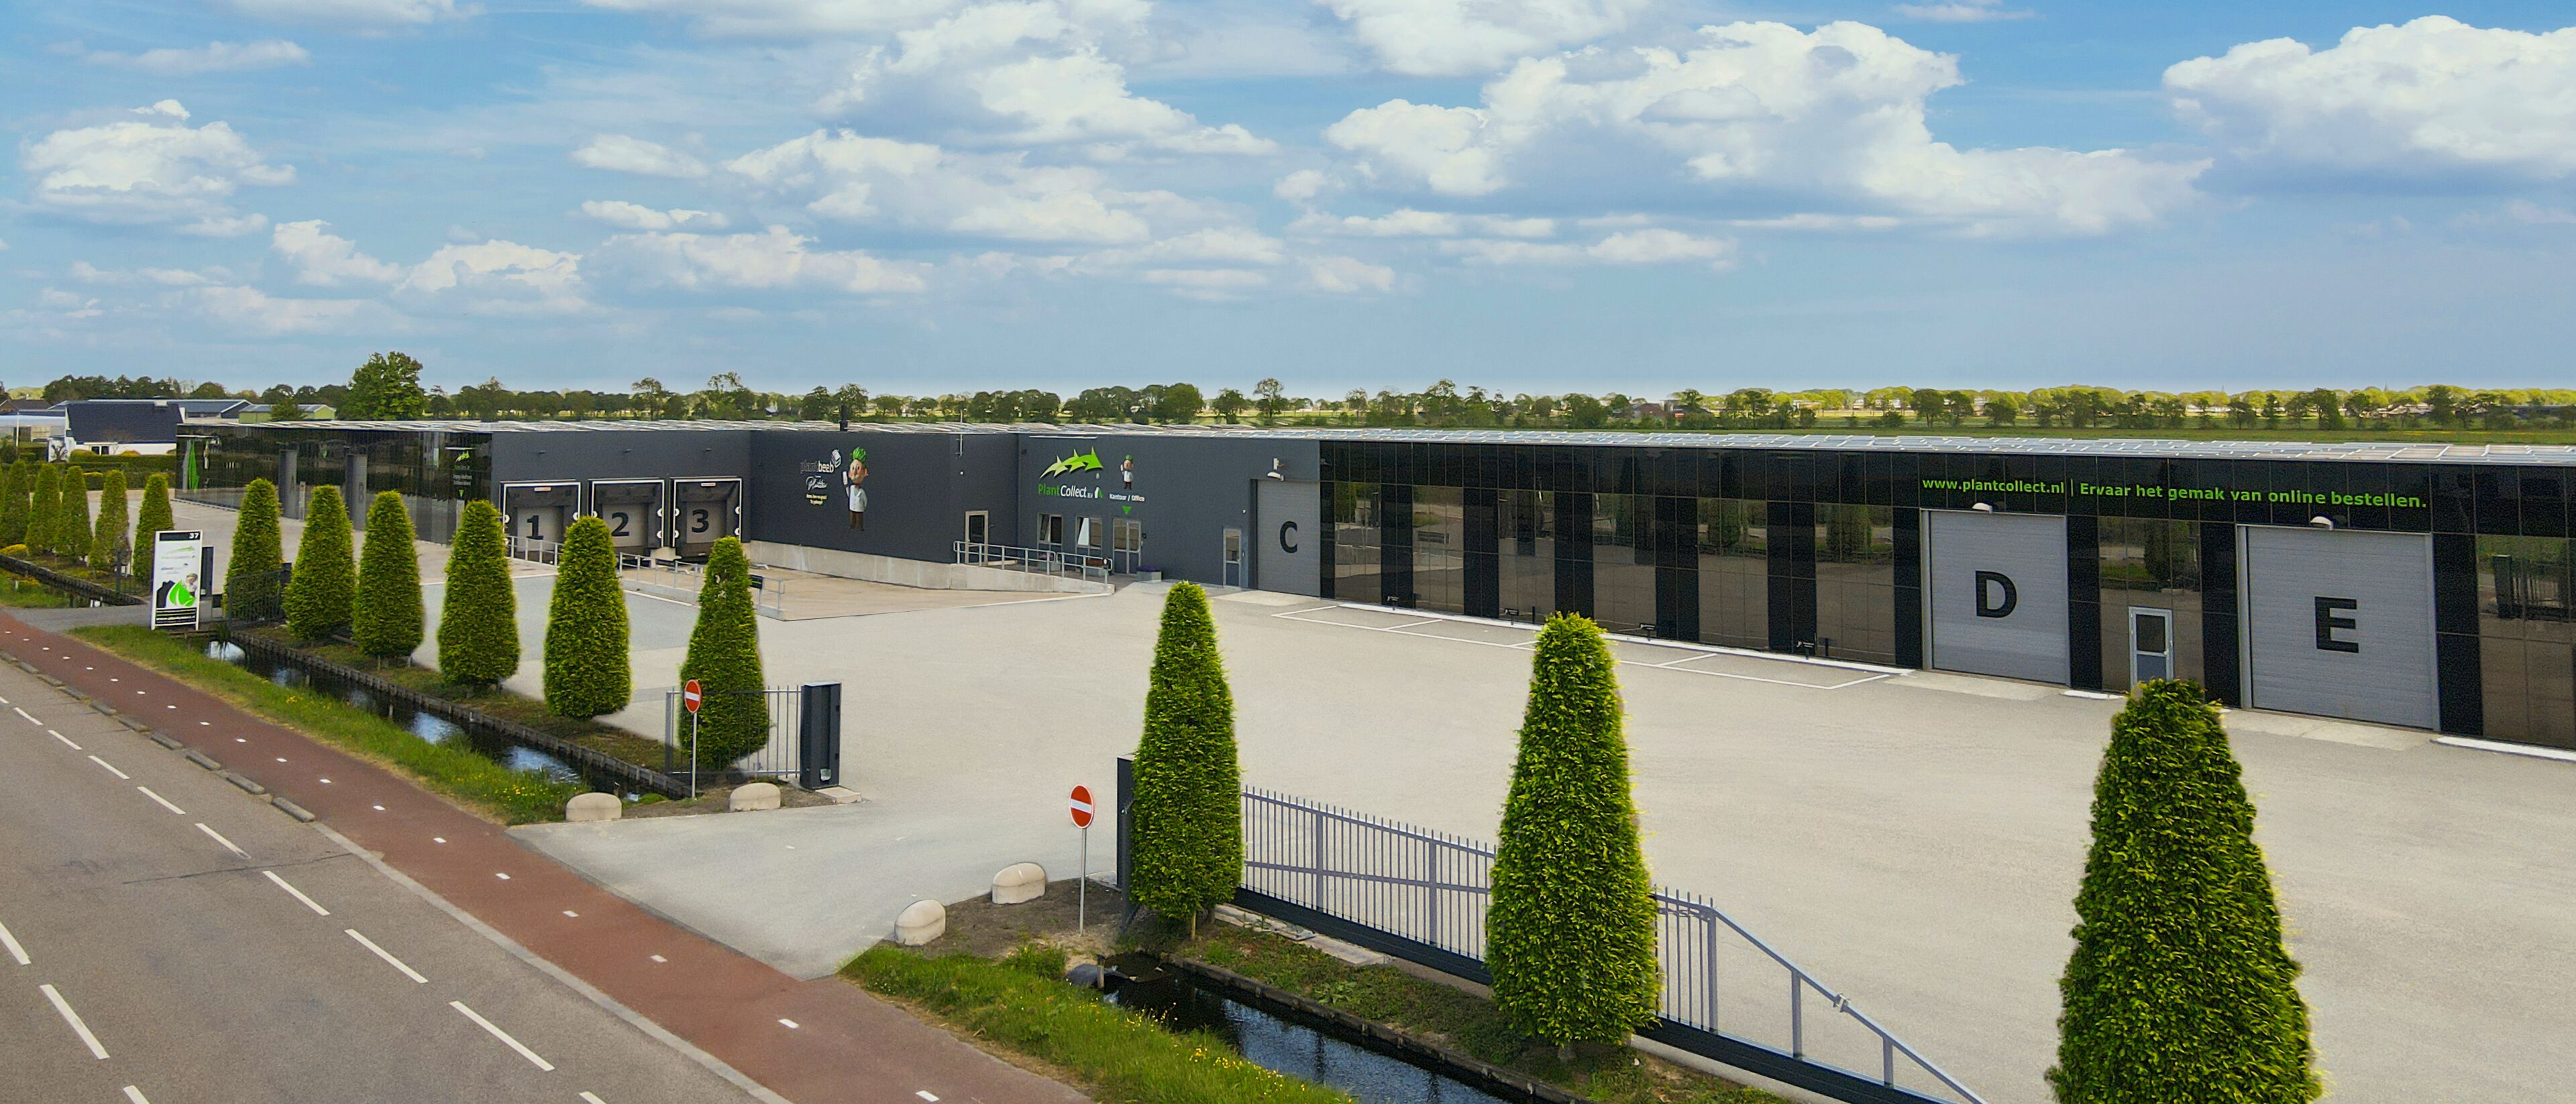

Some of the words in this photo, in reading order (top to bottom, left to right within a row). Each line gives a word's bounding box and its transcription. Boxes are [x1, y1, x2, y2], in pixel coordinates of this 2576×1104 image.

[1038, 484, 1087, 498] PlantCollect
[1922, 479, 2064, 494] www.plantcollect.nl
[2080, 482, 2131, 496] Ervaar
[2136, 484, 2163, 498] het
[2169, 487, 2225, 501] gemak
[2231, 491, 2262, 502] van
[2268, 490, 2326, 504] online
[2331, 491, 2427, 508] bestellen.
[526, 514, 543, 539] 1
[611, 512, 629, 537] 2
[691, 509, 709, 533] 3
[1279, 520, 1297, 553] C
[1975, 570, 2017, 618] D
[2314, 596, 2359, 653] E
